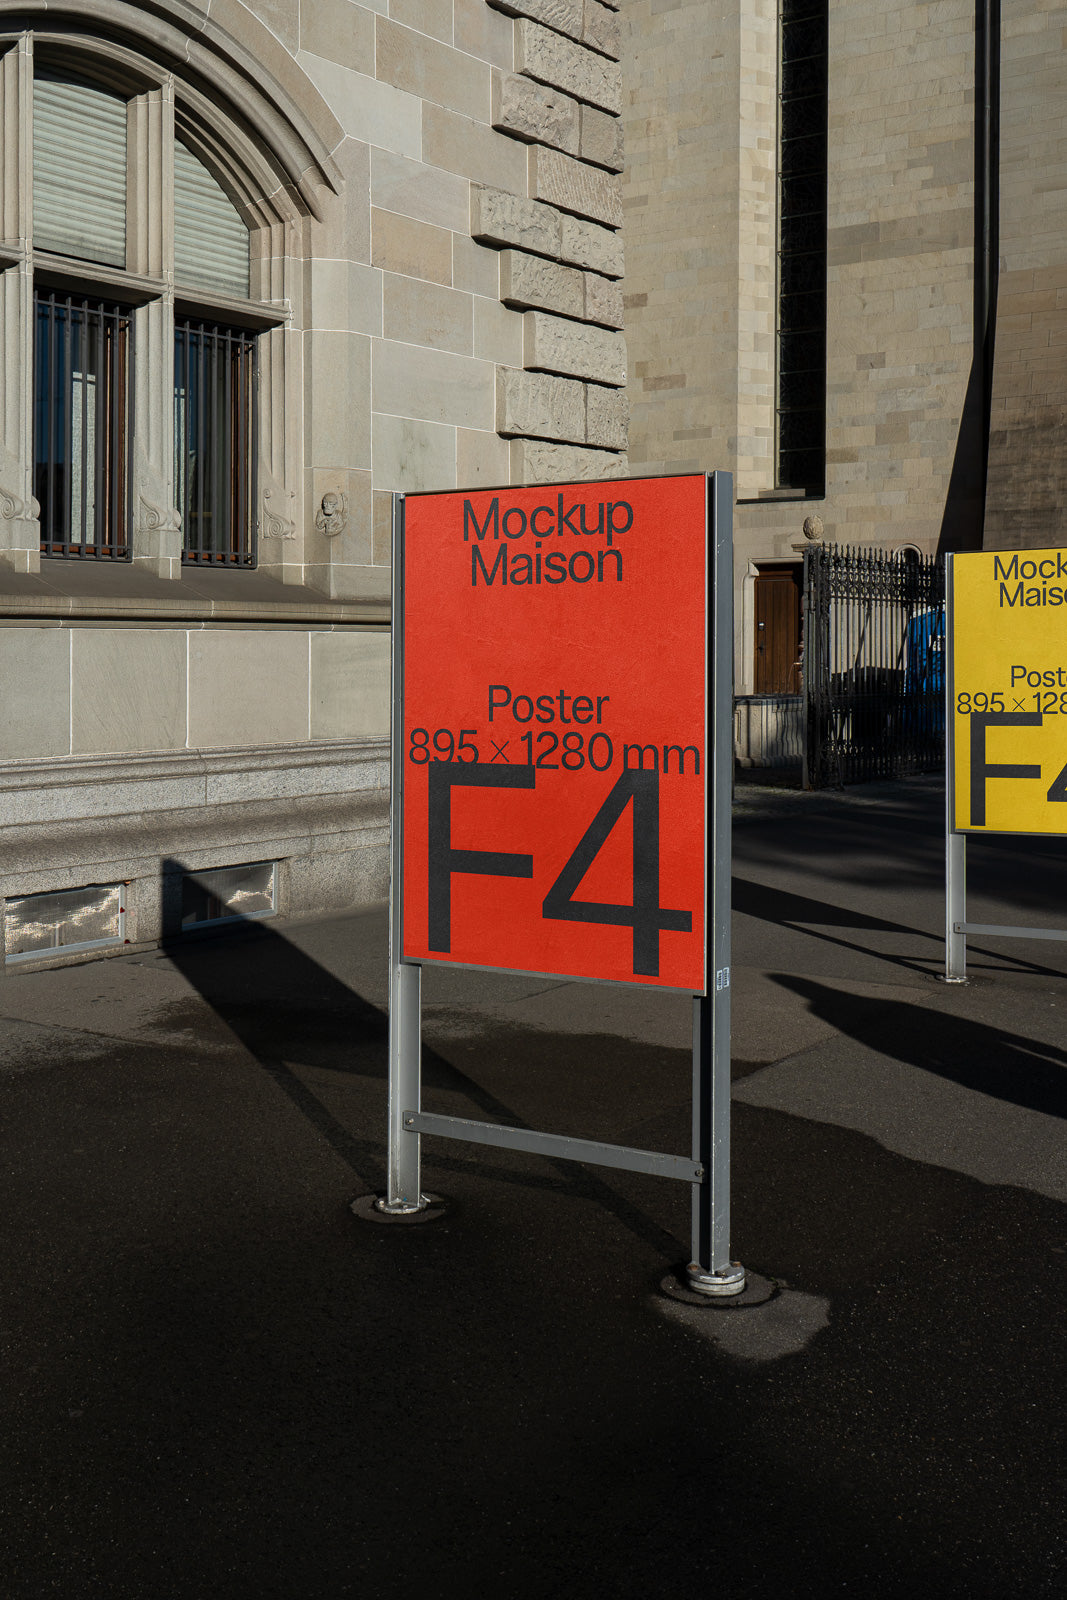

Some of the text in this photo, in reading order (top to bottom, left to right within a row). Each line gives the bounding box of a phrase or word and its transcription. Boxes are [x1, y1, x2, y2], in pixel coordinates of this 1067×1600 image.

[463, 493, 634, 546] Mockup
[471, 541, 623, 586] Maison
[1000, 581, 1067, 608] Mais
[1011, 665, 1067, 688] Post
[488, 685, 609, 724] Poster
[957, 692, 1005, 715] 895
[409, 728, 480, 765] 895
[520, 731, 613, 772] 1280
[623, 743, 701, 775] mm
[970, 711, 1067, 827] F
[428, 761, 693, 977] F4
